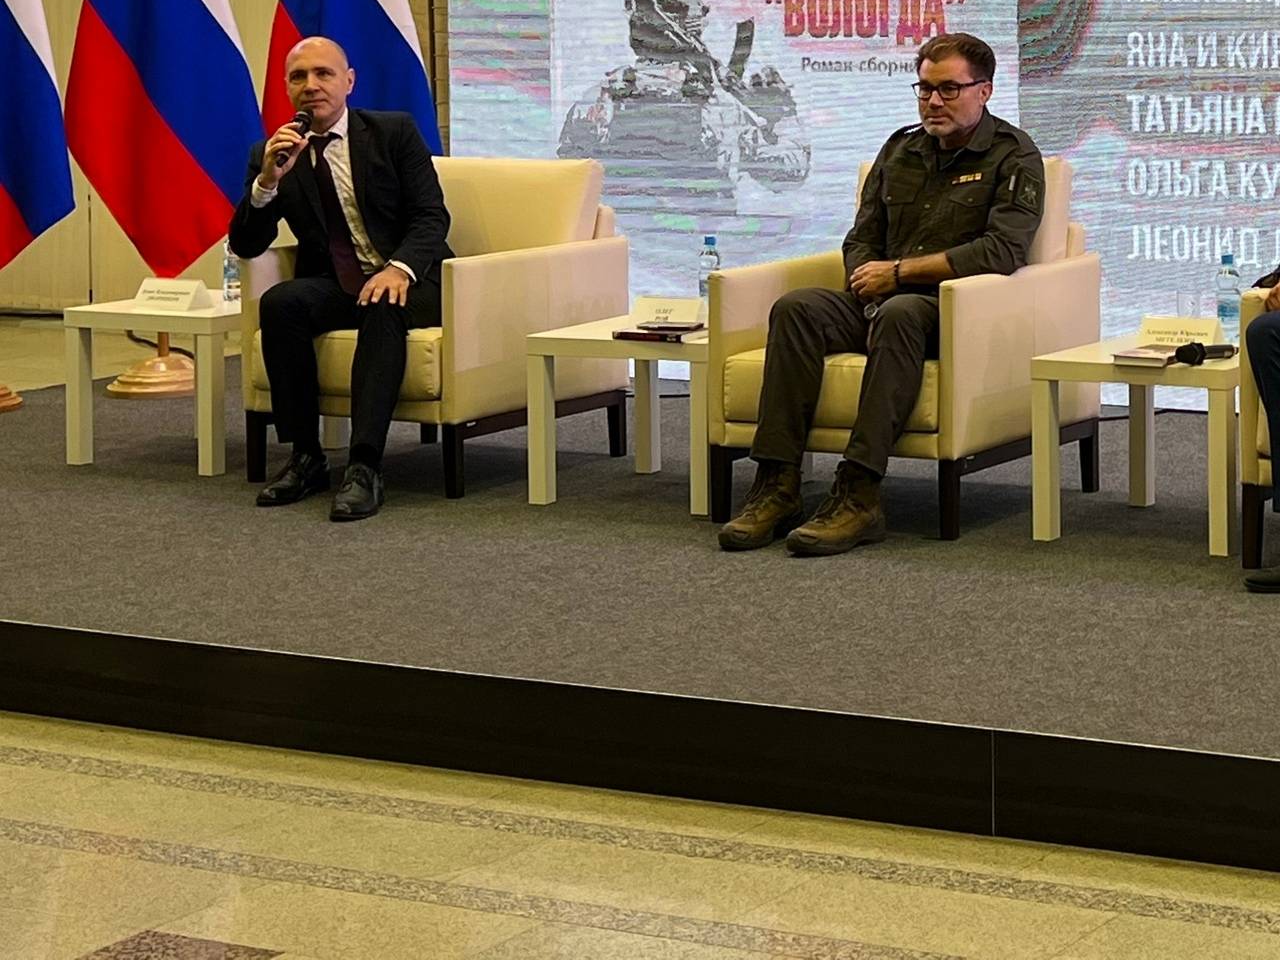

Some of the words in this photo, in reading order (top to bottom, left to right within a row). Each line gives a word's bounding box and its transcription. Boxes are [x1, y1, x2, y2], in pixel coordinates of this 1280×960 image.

[1126, 32, 1187, 68] ЯНА
[1198, 32, 1219, 68] И
[1126, 95, 1267, 135] ТАТЬЯНА
[1128, 159, 1230, 199] ОЛЬГА
